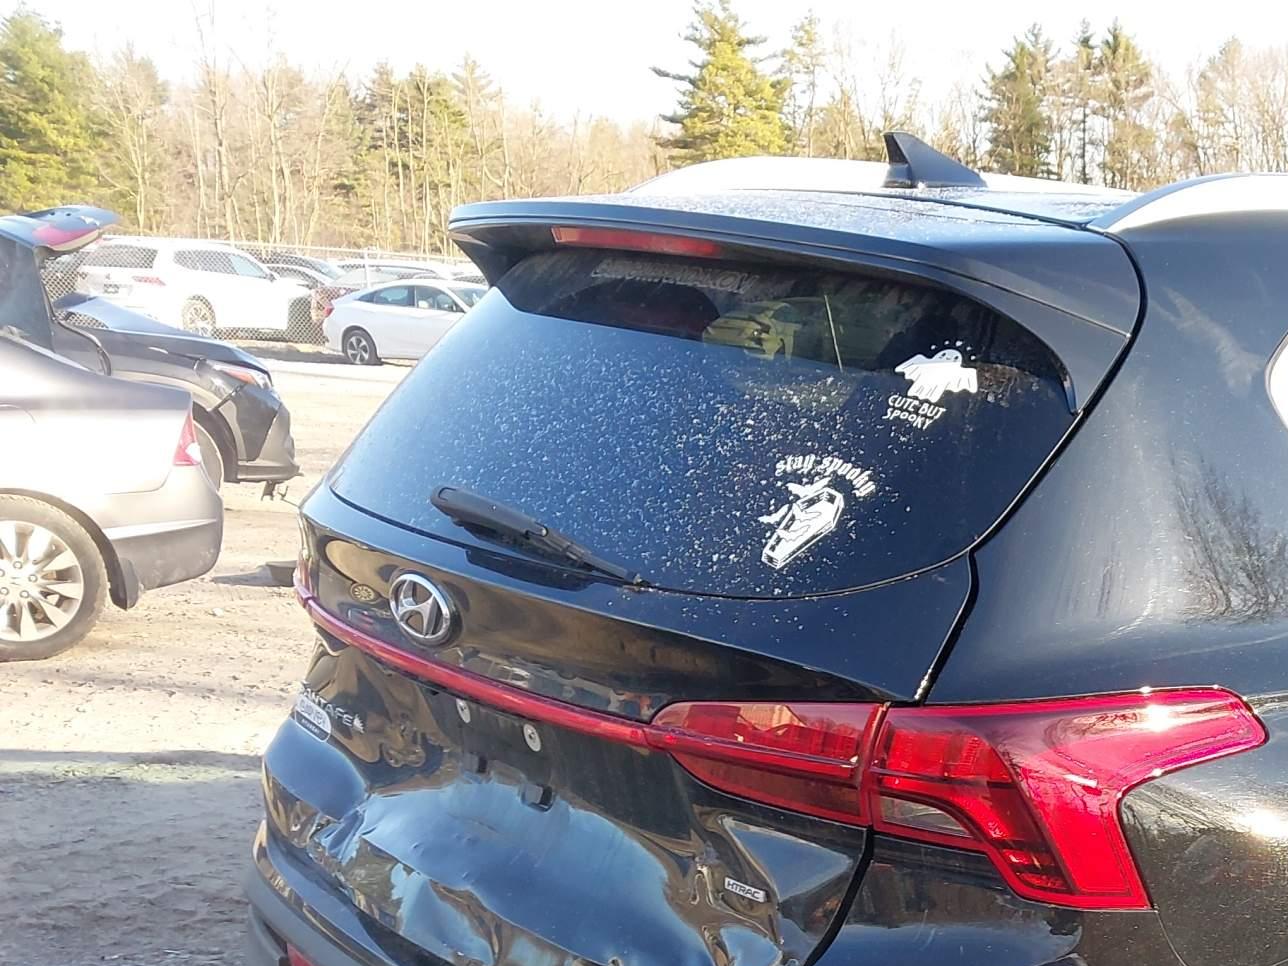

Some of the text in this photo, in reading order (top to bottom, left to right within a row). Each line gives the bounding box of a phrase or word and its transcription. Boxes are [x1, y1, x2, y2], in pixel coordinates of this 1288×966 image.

[882, 407, 934, 430] SPOOKY
[888, 394, 946, 420] CUTE BUT
[775, 453, 816, 478] stay
[727, 879, 761, 899] HTRAC
